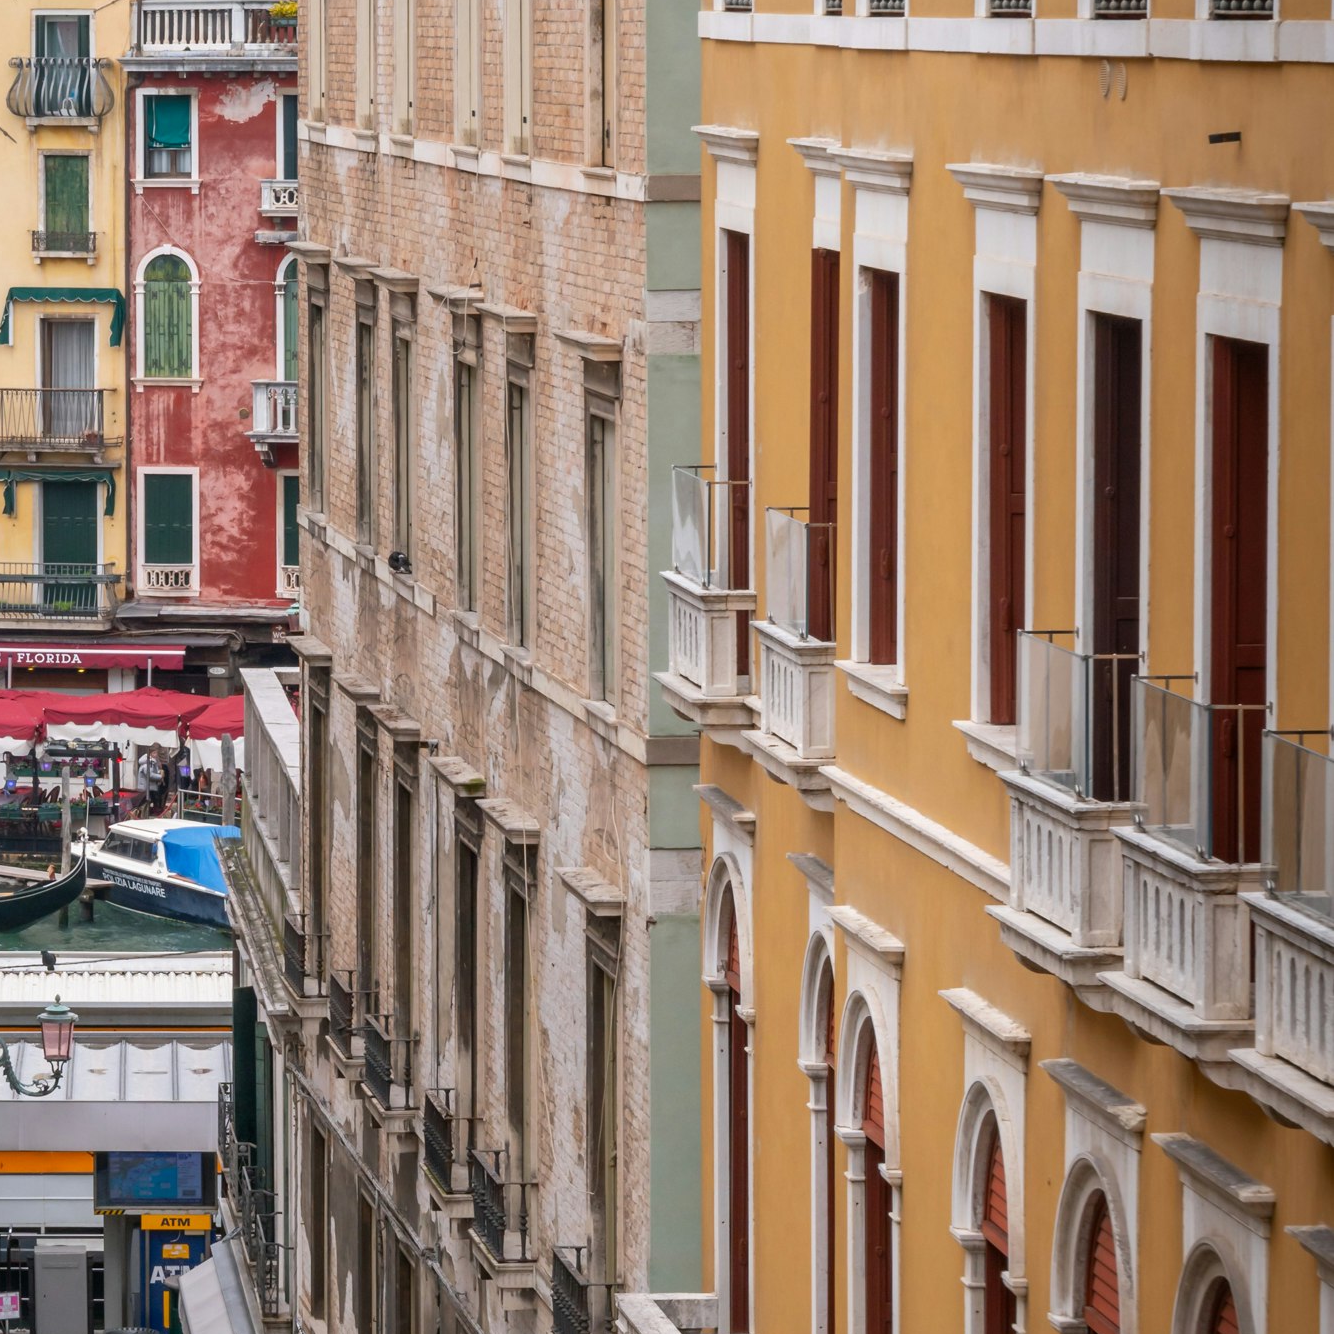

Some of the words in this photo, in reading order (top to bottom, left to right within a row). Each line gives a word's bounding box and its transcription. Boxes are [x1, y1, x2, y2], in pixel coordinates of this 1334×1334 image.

[272, 631, 286, 639] WC
[16, 652, 82, 664] FLORIDA
[102, 872, 128, 887] POLIZIA
[128, 880, 166, 898] LAGUNARE
[161, 1218, 190, 1226] ATM
